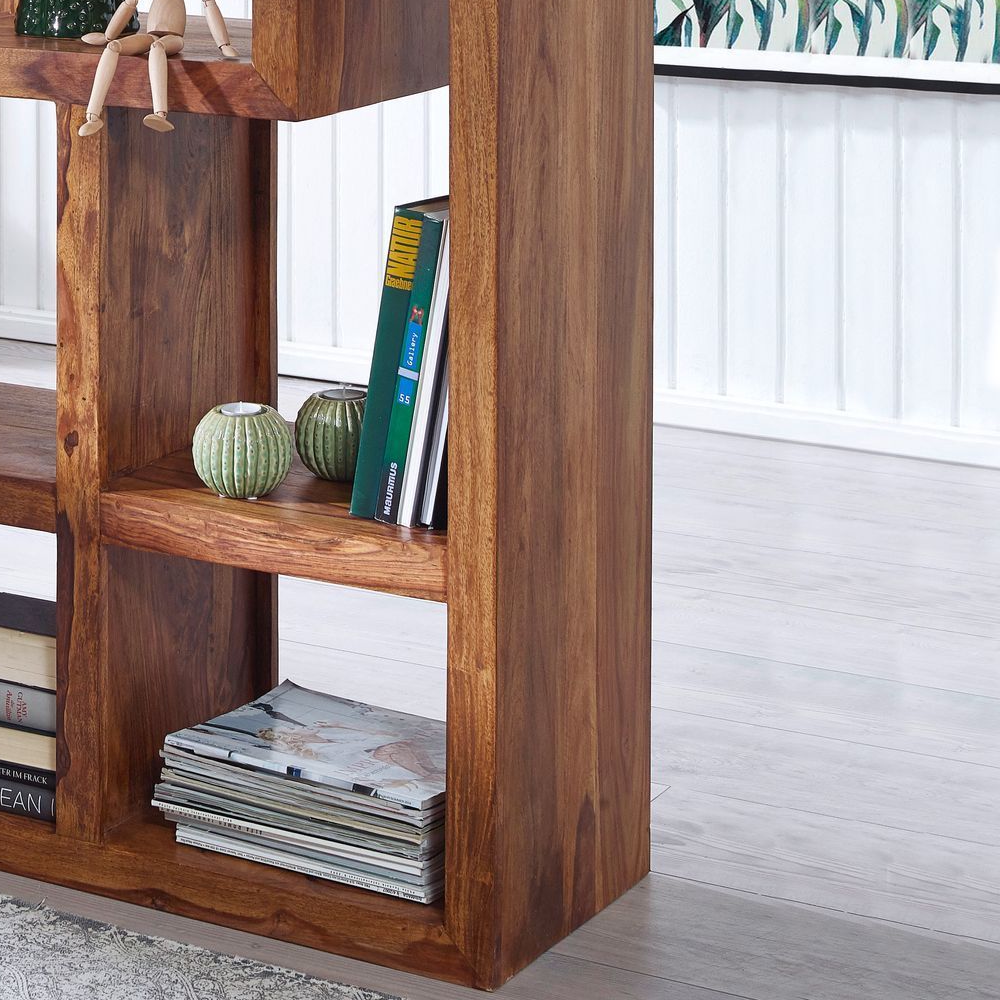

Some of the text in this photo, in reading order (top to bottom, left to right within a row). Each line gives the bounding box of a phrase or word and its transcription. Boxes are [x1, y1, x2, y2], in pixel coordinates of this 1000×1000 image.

[387, 215, 424, 279] NATUR
[385, 274, 413, 291] Graebne
[12, 770, 22, 779] IM
[23, 773, 48, 785] FRACK
